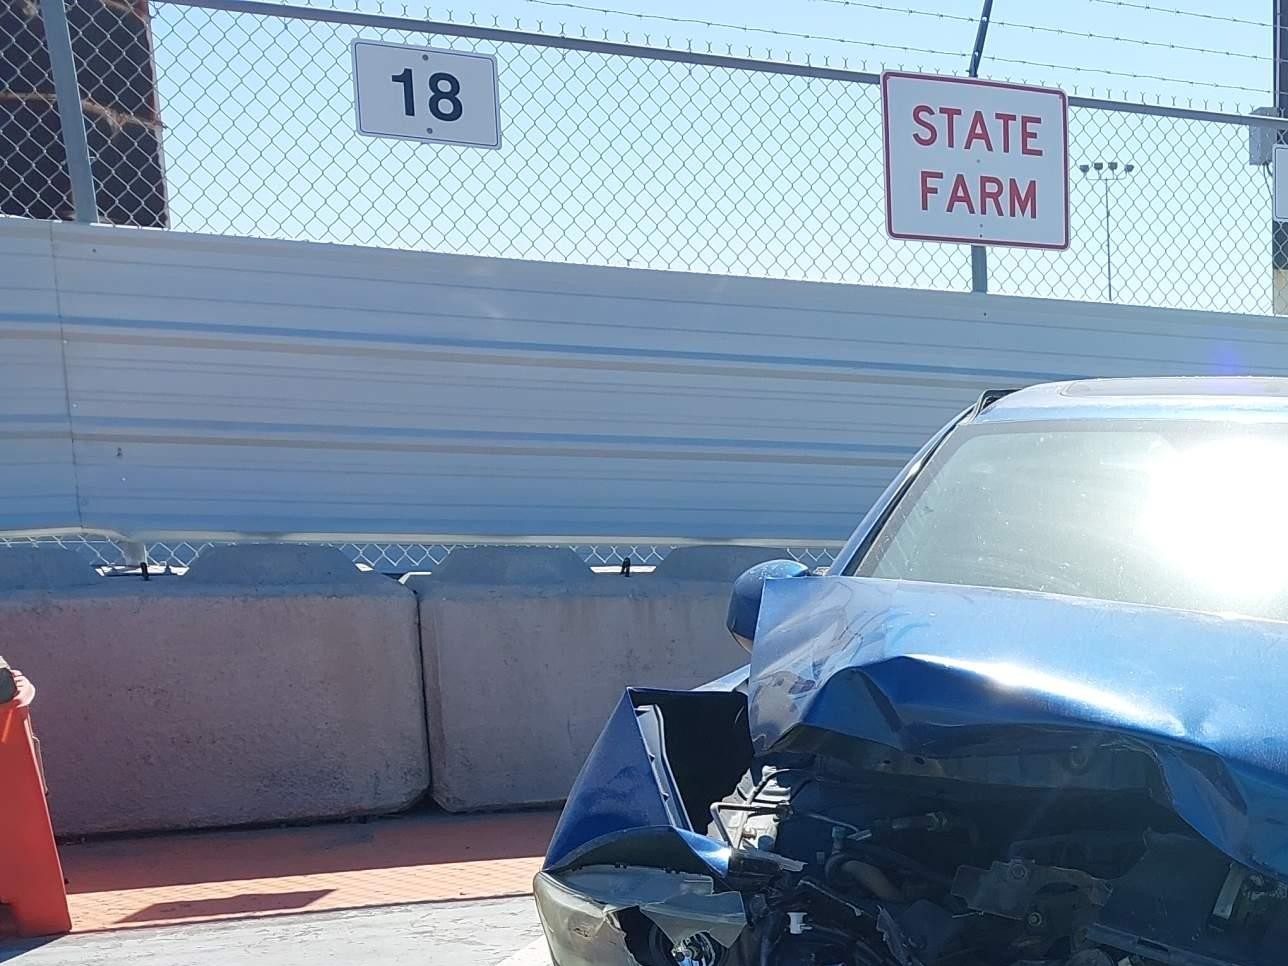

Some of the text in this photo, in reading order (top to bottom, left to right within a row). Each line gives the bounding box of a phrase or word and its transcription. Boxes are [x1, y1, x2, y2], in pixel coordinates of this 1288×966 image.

[391, 67, 463, 122] 18
[912, 104, 1044, 157] STATE
[919, 170, 1037, 220] FARM
